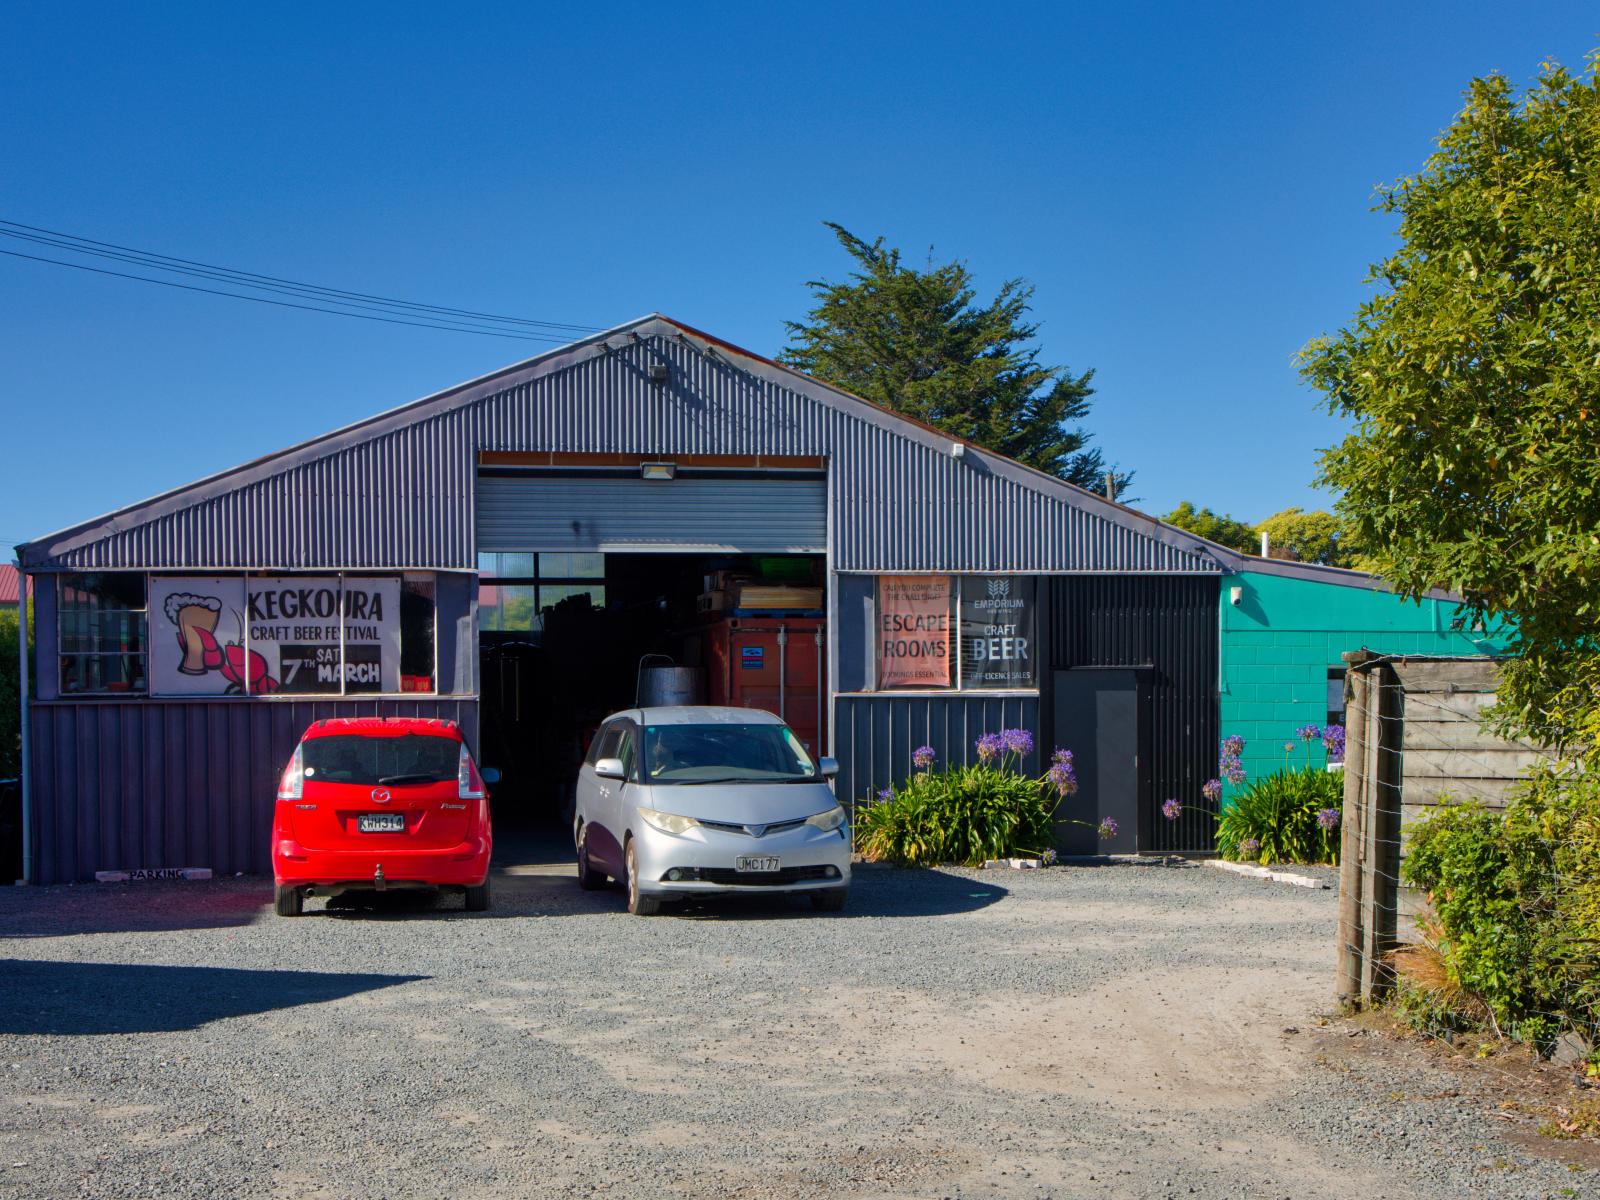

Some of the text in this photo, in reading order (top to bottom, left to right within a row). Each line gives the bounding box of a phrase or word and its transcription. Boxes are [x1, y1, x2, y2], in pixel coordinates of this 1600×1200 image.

[248, 588, 383, 621] KEGKOURA
[974, 599, 1025, 609] EMPORIUM
[883, 614, 947, 632] ESCAPE
[984, 624, 1016, 636] CRAFT
[250, 626, 381, 640] CRAFT BEER FESTIVAL
[316, 648, 341, 662] SAT
[884, 640, 946, 658] ROOMS
[973, 637, 1028, 660] BEER
[318, 662, 380, 683] MARCH
[359, 816, 403, 829] KWH314
[738, 858, 779, 870] JMC177
[129, 869, 184, 880] PARKING
